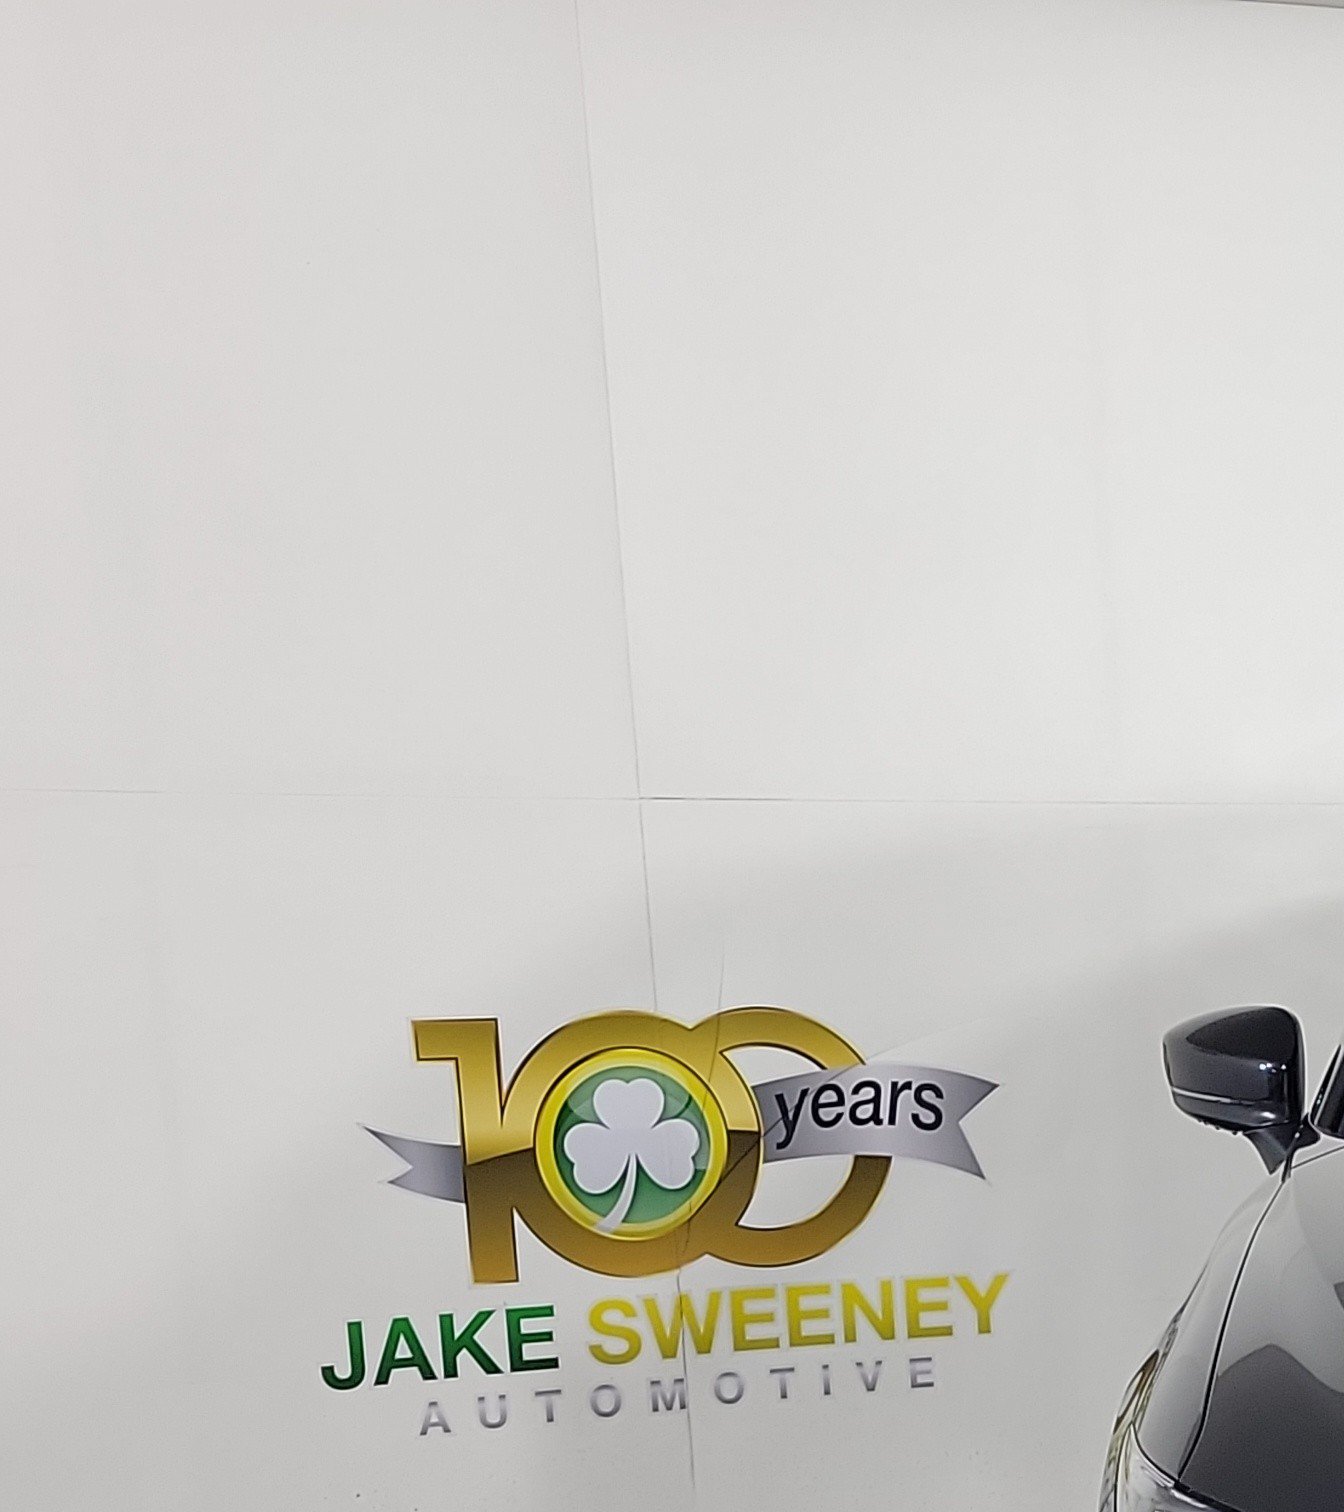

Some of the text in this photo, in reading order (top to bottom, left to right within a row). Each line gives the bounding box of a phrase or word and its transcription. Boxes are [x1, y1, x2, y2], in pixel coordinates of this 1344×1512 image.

[411, 1006, 944, 1285] 100 years
[320, 1272, 1010, 1391] JAKE SWEENEY
[419, 1356, 935, 1436] AUTOMOTIVE
